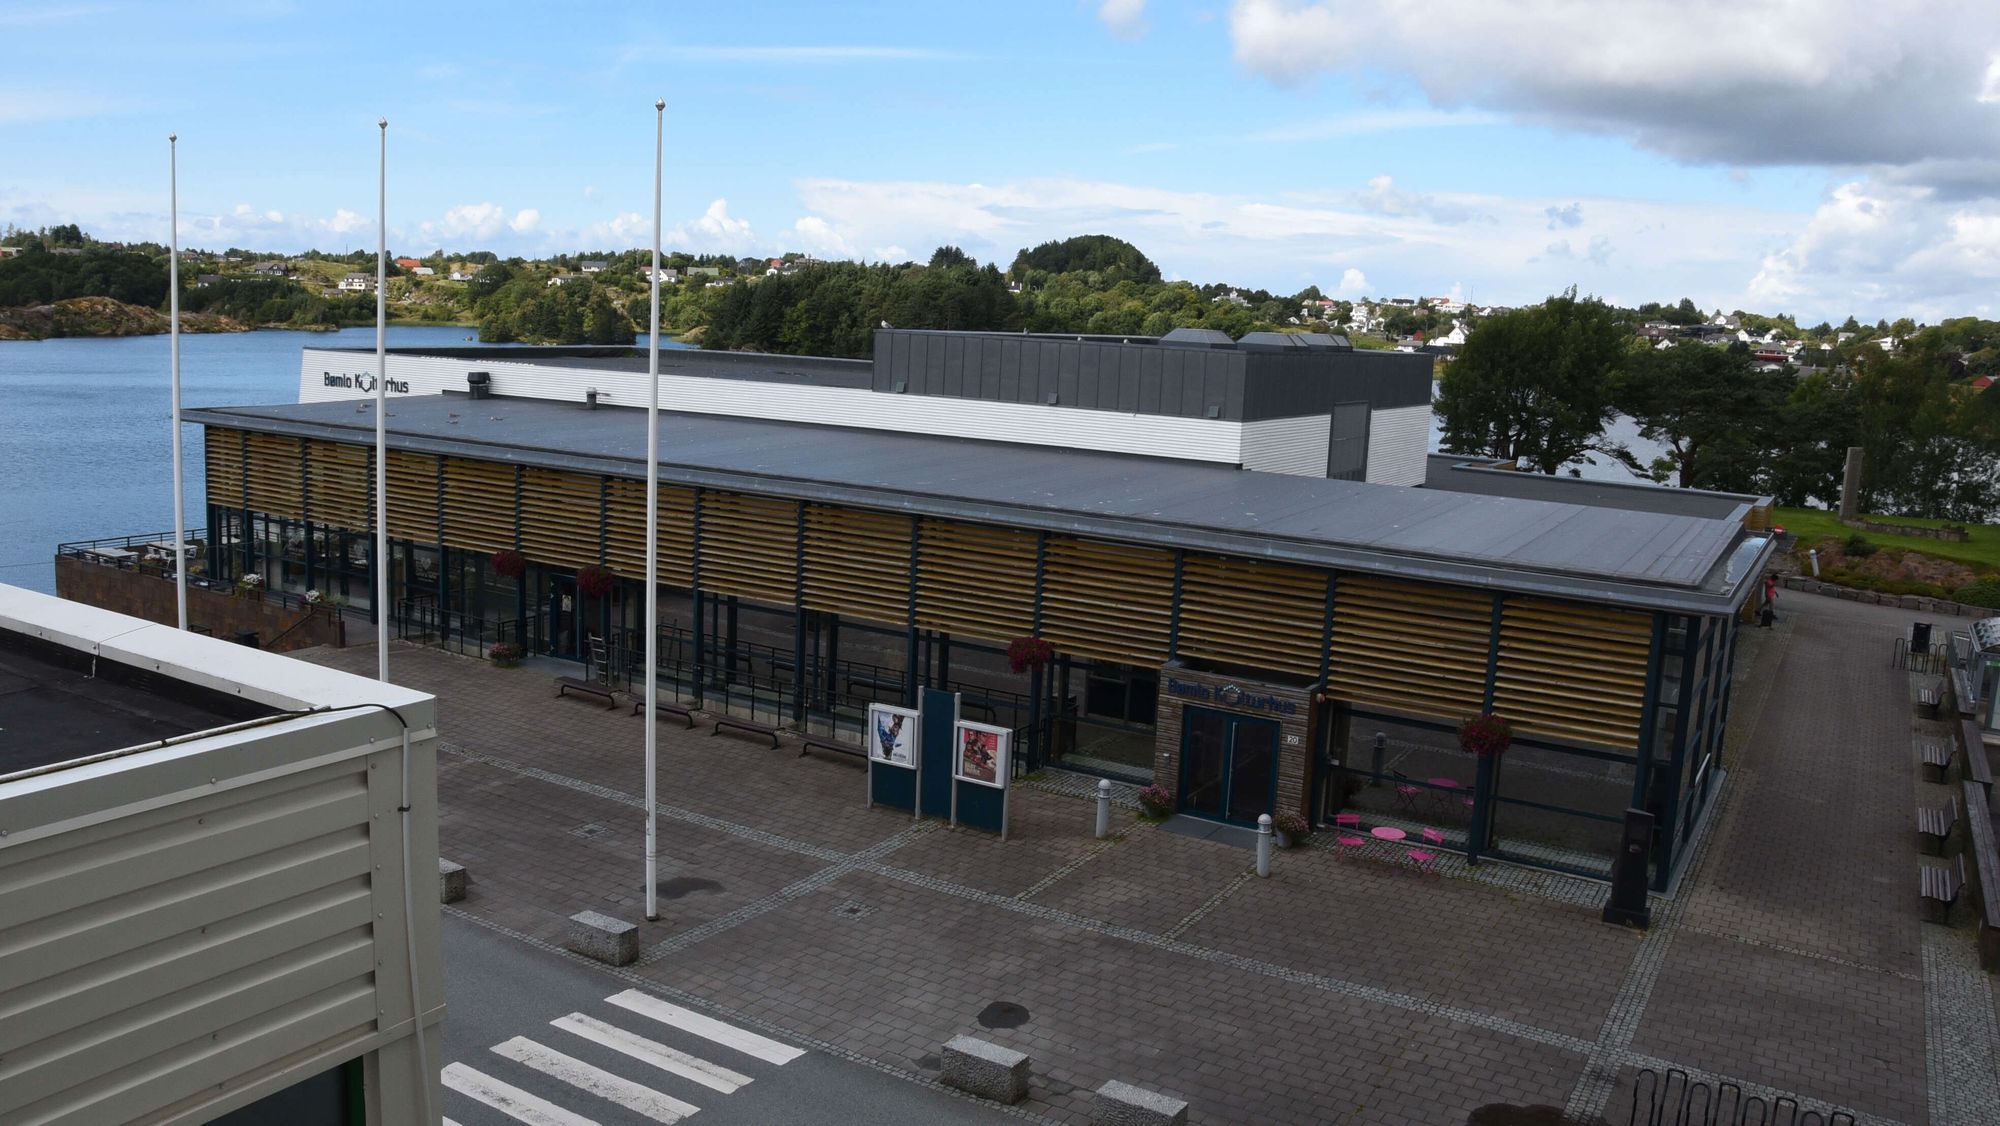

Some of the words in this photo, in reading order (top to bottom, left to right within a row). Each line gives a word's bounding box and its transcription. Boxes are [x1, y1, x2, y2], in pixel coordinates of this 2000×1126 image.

[324, 372, 352, 388] Bømlo
[355, 372, 409, 393] Kultrhus
[1288, 736, 1298, 744] 20
